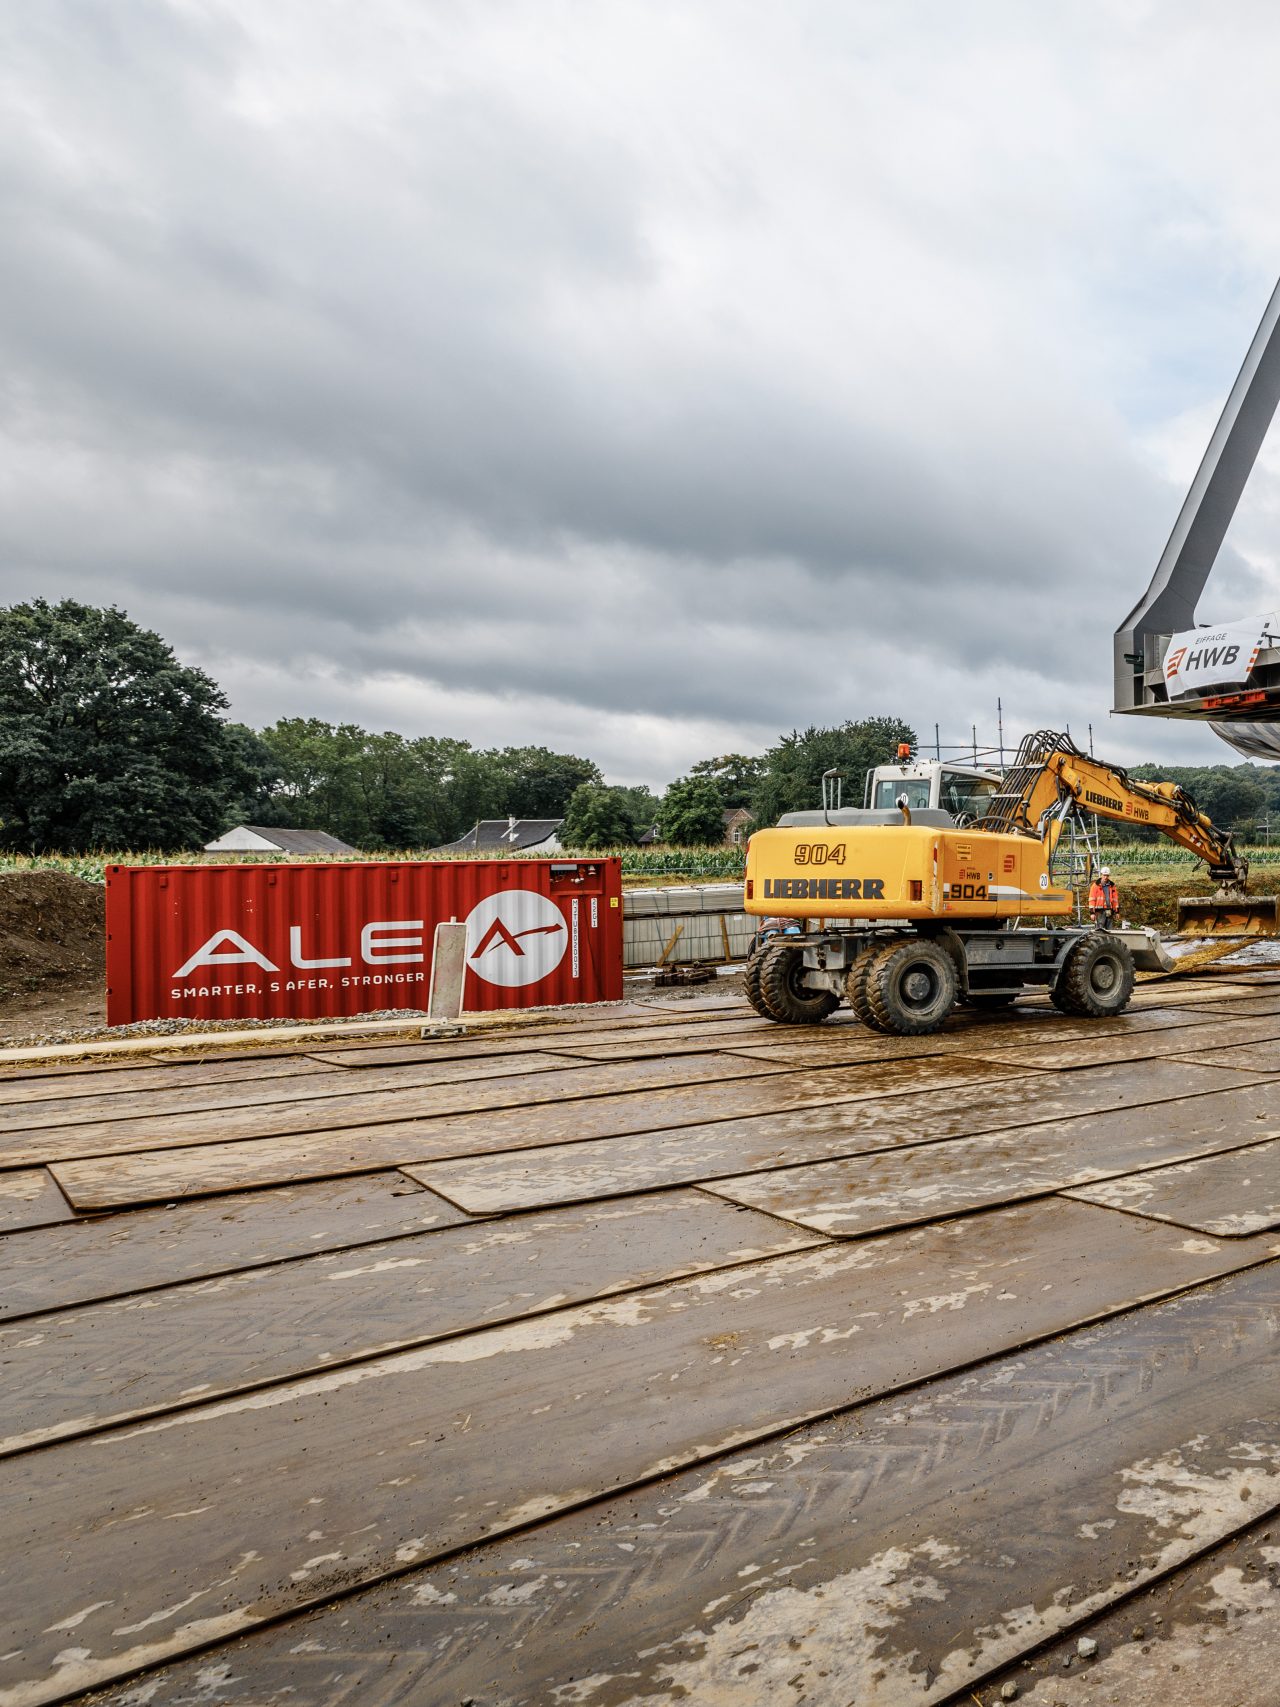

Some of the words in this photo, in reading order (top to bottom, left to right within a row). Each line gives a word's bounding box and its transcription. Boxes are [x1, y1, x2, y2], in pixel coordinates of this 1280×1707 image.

[1195, 633, 1228, 645] EIFFAGE
[1185, 645, 1240, 671] HWB
[1085, 790, 1123, 812] LIEBHERR
[1133, 806, 1149, 821] HWB
[794, 844, 846, 865] 904
[966, 872, 981, 880] HWB
[1041, 875, 1048, 887] 20
[764, 879, 885, 899] LIEBHERR
[951, 884, 987, 899] 904
[171, 920, 424, 978] ALE
[171, 983, 262, 999] SMARTER,
[341, 972, 425, 987] STRONGER
